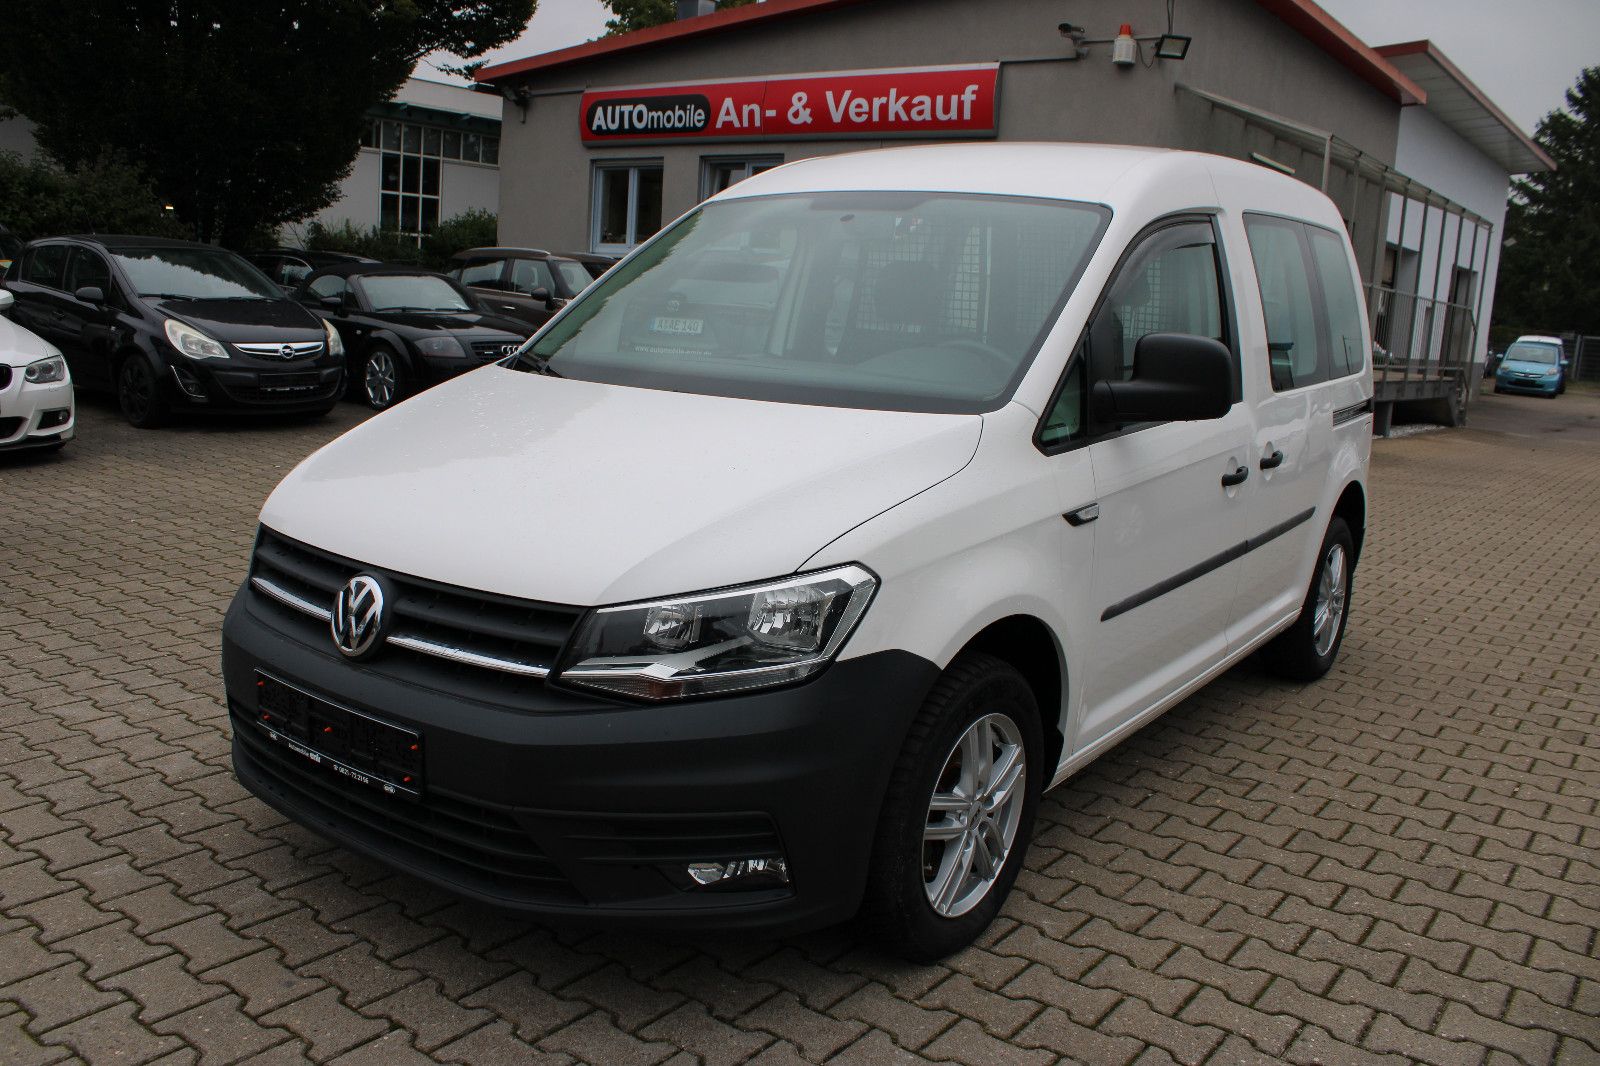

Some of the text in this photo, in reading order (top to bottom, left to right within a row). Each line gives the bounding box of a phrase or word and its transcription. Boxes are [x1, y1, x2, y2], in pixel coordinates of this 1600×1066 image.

[591, 84, 979, 131] AUTOmobile An- & Verkauf
